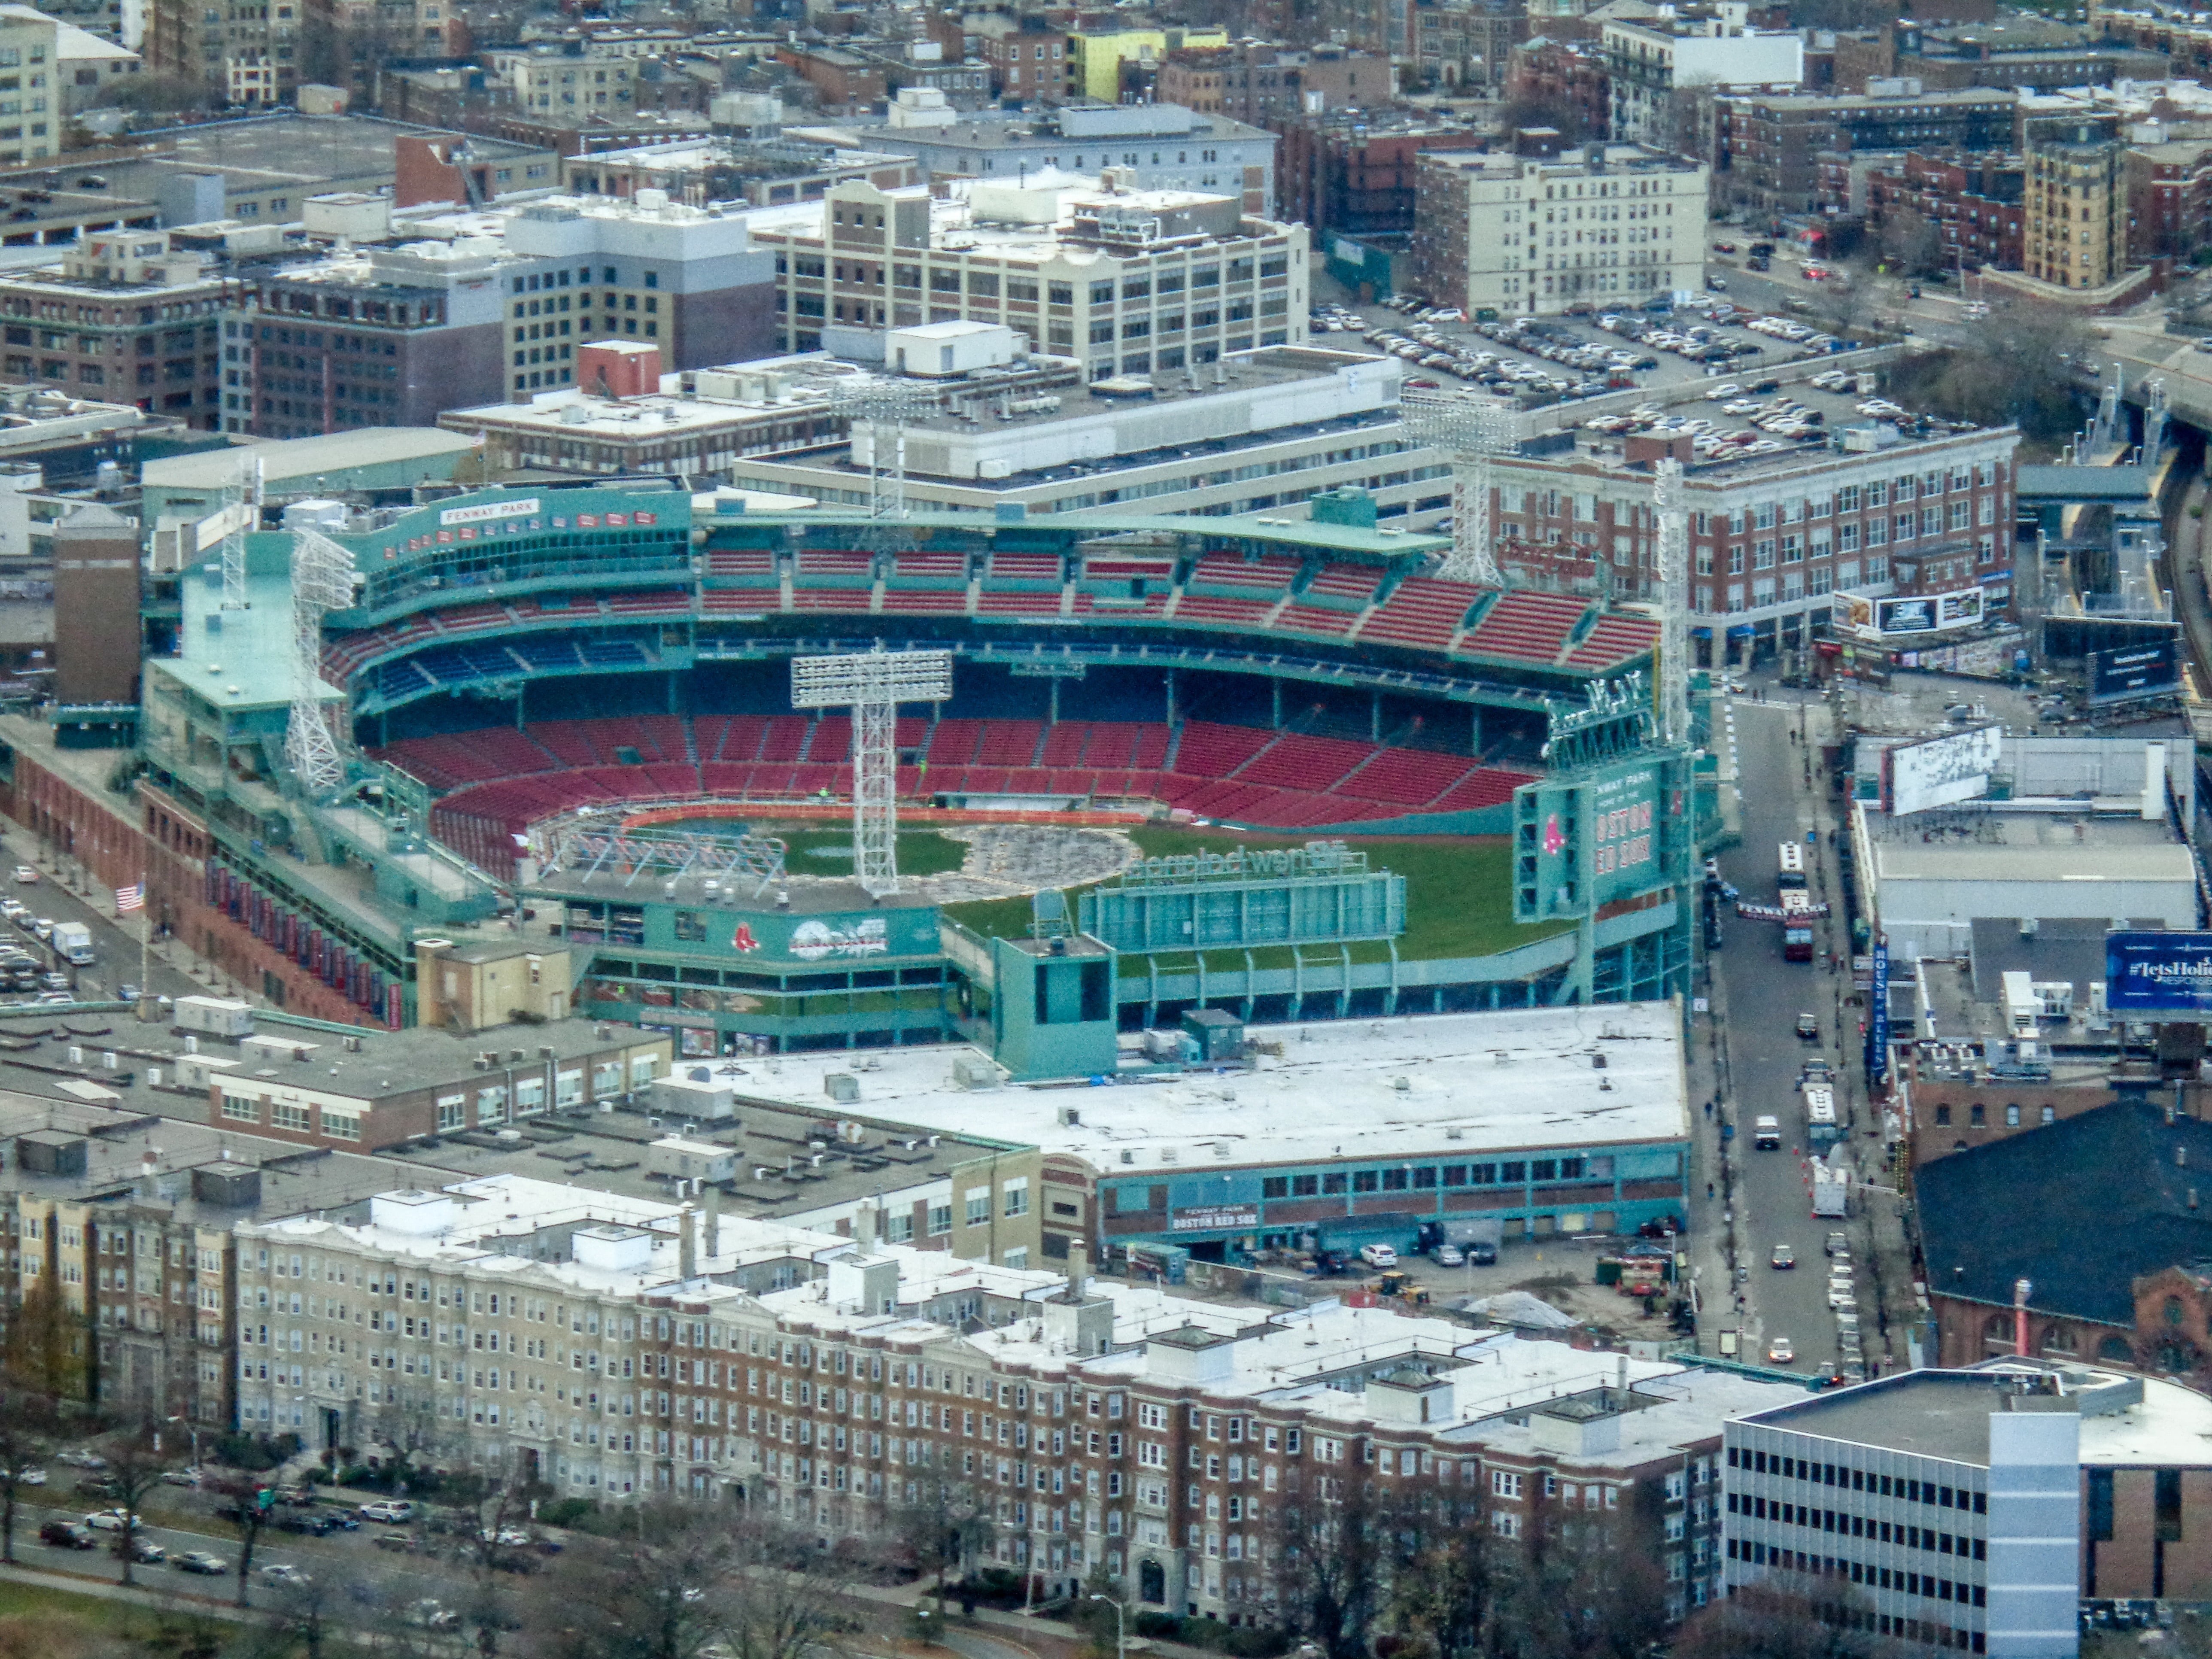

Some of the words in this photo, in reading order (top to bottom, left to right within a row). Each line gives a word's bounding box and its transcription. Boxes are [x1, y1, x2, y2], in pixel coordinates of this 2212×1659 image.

[446, 508, 493, 521] FENWAY
[501, 502, 533, 513] PARK
[1596, 800, 1651, 842] OSTON
[1596, 845, 1616, 875] ED
[1620, 834, 1650, 868] SOX
[1876, 950, 1886, 1000] HOUSE
[1173, 1217, 1212, 1229] BOSTON
[1215, 1215, 1236, 1226] RED
[1237, 1214, 1257, 1224] SOX
